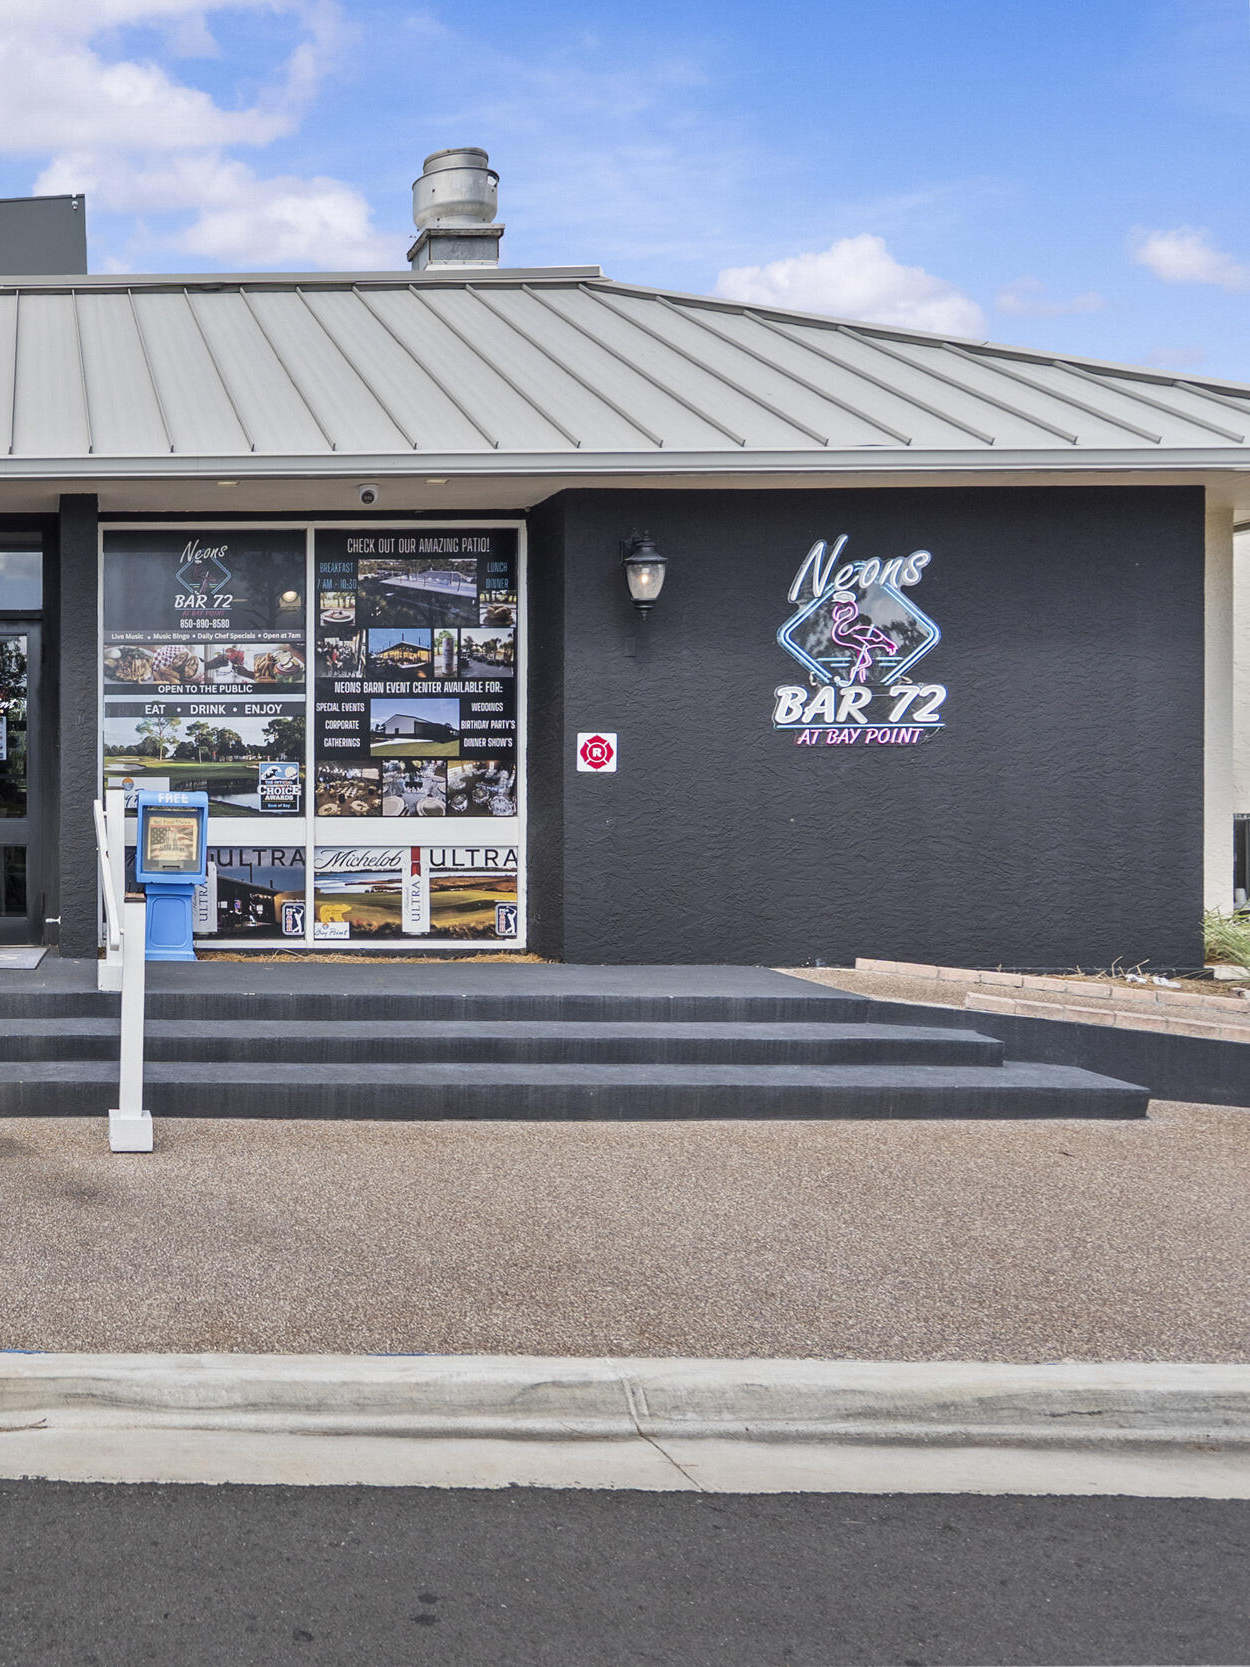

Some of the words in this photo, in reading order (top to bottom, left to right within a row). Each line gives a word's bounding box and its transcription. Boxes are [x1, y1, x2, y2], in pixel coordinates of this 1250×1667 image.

[180, 539, 228, 563] Neons
[347, 538, 375, 553] CHECK
[379, 538, 395, 553] OUT
[399, 538, 416, 553] OUR
[419, 538, 458, 552] AMAZING
[462, 538, 490, 552] PATIO!
[320, 562, 354, 573] BREAKFAST
[487, 562, 507, 573] LUNCH
[790, 535, 930, 601] Neons
[175, 595, 206, 608] BAR
[214, 595, 233, 608] 72
[180, 619, 230, 628] 850-890-8580
[173, 633, 190, 641] Bingo
[198, 633, 212, 641] Daily
[230, 632, 255, 641] Specials
[158, 685, 182, 693] OPEN
[185, 685, 197, 693] TO
[199, 685, 217, 693] THE
[220, 685, 252, 693] PUBLIC
[335, 682, 361, 693] NEONS
[364, 682, 384, 693] BARN
[386, 682, 410, 693] EVENT
[413, 682, 441, 693] CENTER
[444, 682, 482, 693] AVAILABLE
[486, 682, 502, 693] FOR:
[145, 705, 165, 714] EAT
[191, 705, 226, 714] DRINK
[245, 704, 282, 714] ENJOY
[316, 703, 340, 712] SPECIAL
[342, 703, 364, 712] EVENTS
[471, 703, 503, 712] WEDDINGS
[775, 686, 872, 724] BAR
[889, 685, 946, 723] 72
[325, 720, 359, 730] CORPORATE
[461, 720, 489, 729] BIRTHDAY
[490, 720, 515, 729] PARTY'S
[797, 729, 822, 744] AT
[827, 729, 861, 744] BAY
[865, 728, 923, 744] POINT
[324, 738, 360, 748] GATHERINGS
[464, 738, 486, 747] DINNER
[592, 748, 602, 757] R
[258, 784, 301, 795] CHOICE
[158, 793, 188, 804] FREE
[217, 849, 306, 867] ULTRA
[315, 850, 404, 868] Michelob
[430, 849, 517, 866] ULTRA
[411, 881, 420, 922] ULTRA
